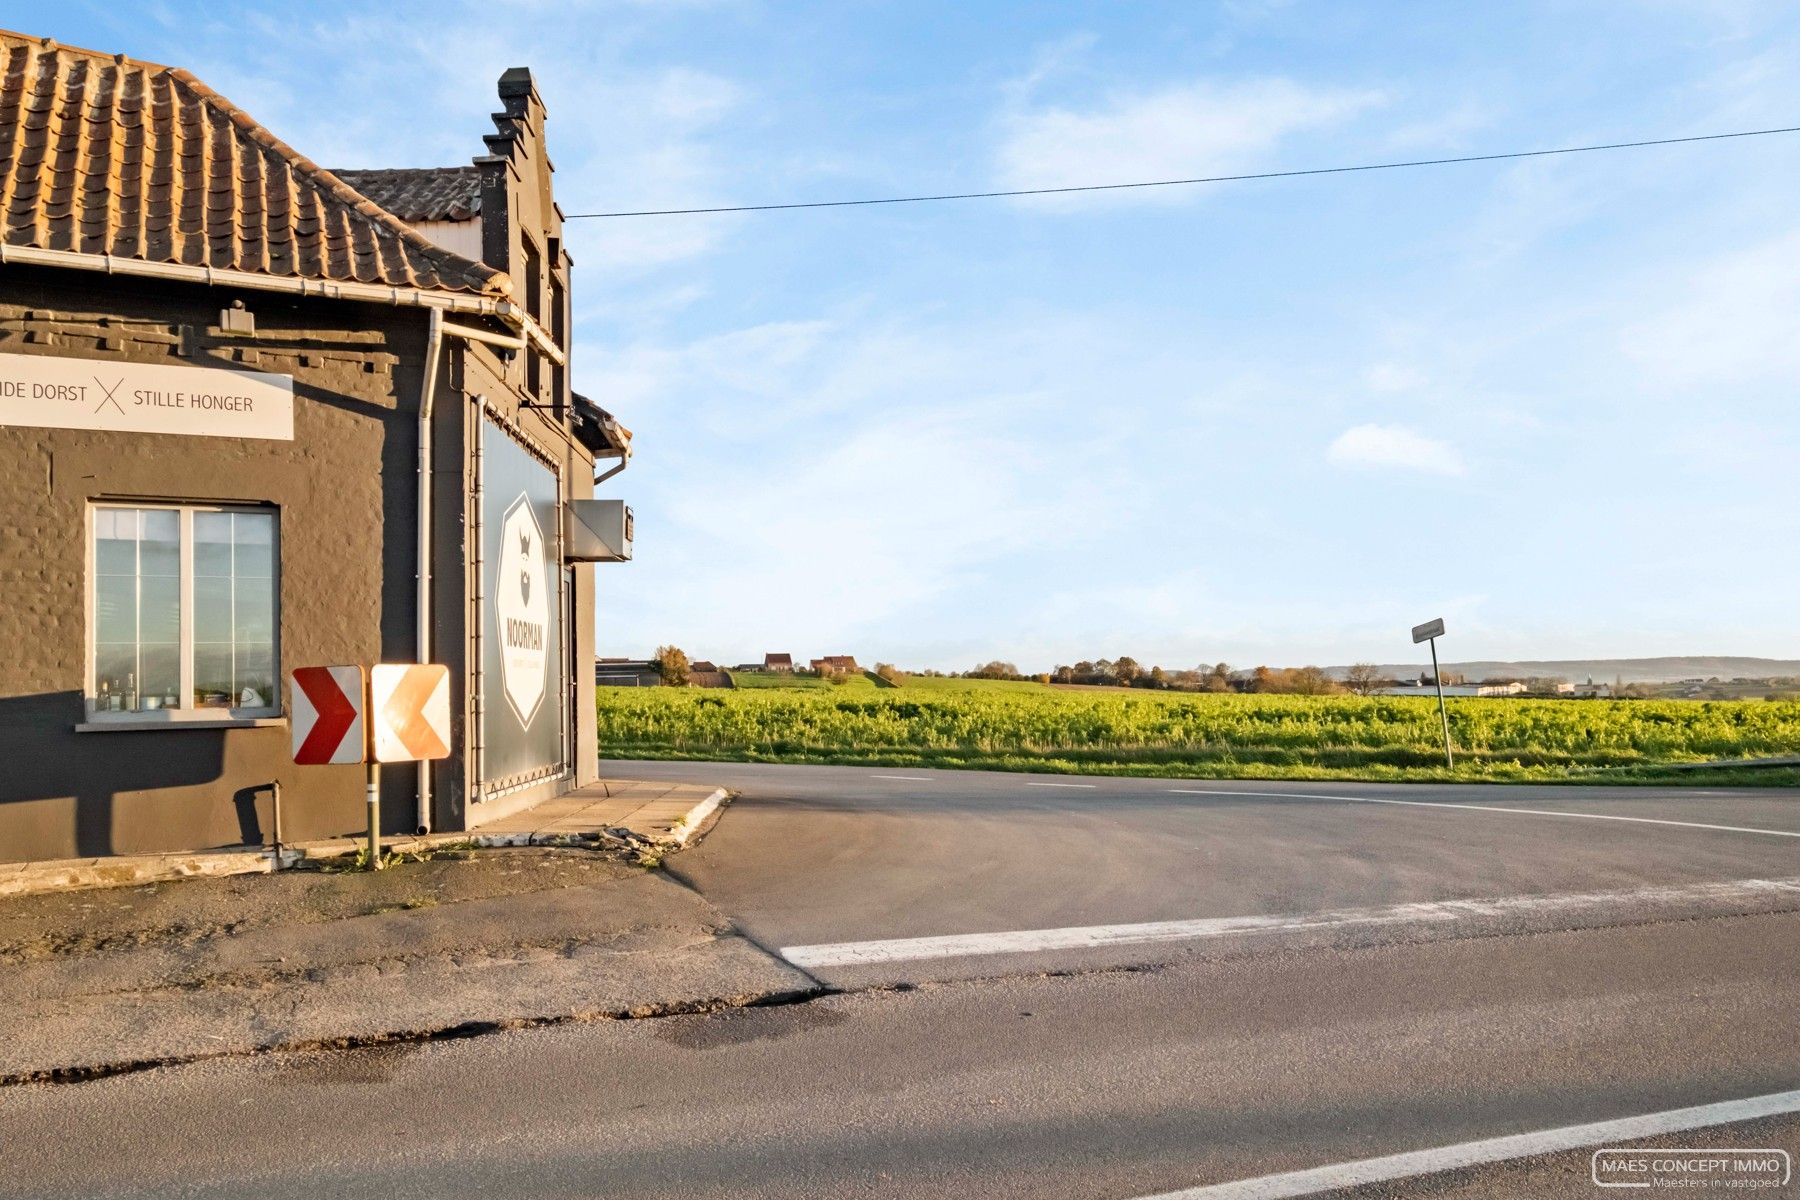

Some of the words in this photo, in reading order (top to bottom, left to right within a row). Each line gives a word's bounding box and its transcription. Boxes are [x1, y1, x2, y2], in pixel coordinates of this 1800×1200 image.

[0, 381, 26, 398] DE
[33, 384, 87, 402] DORST
[134, 390, 185, 408] STILLE
[191, 394, 253, 412] HONGER
[507, 618, 542, 651] NOORMAN
